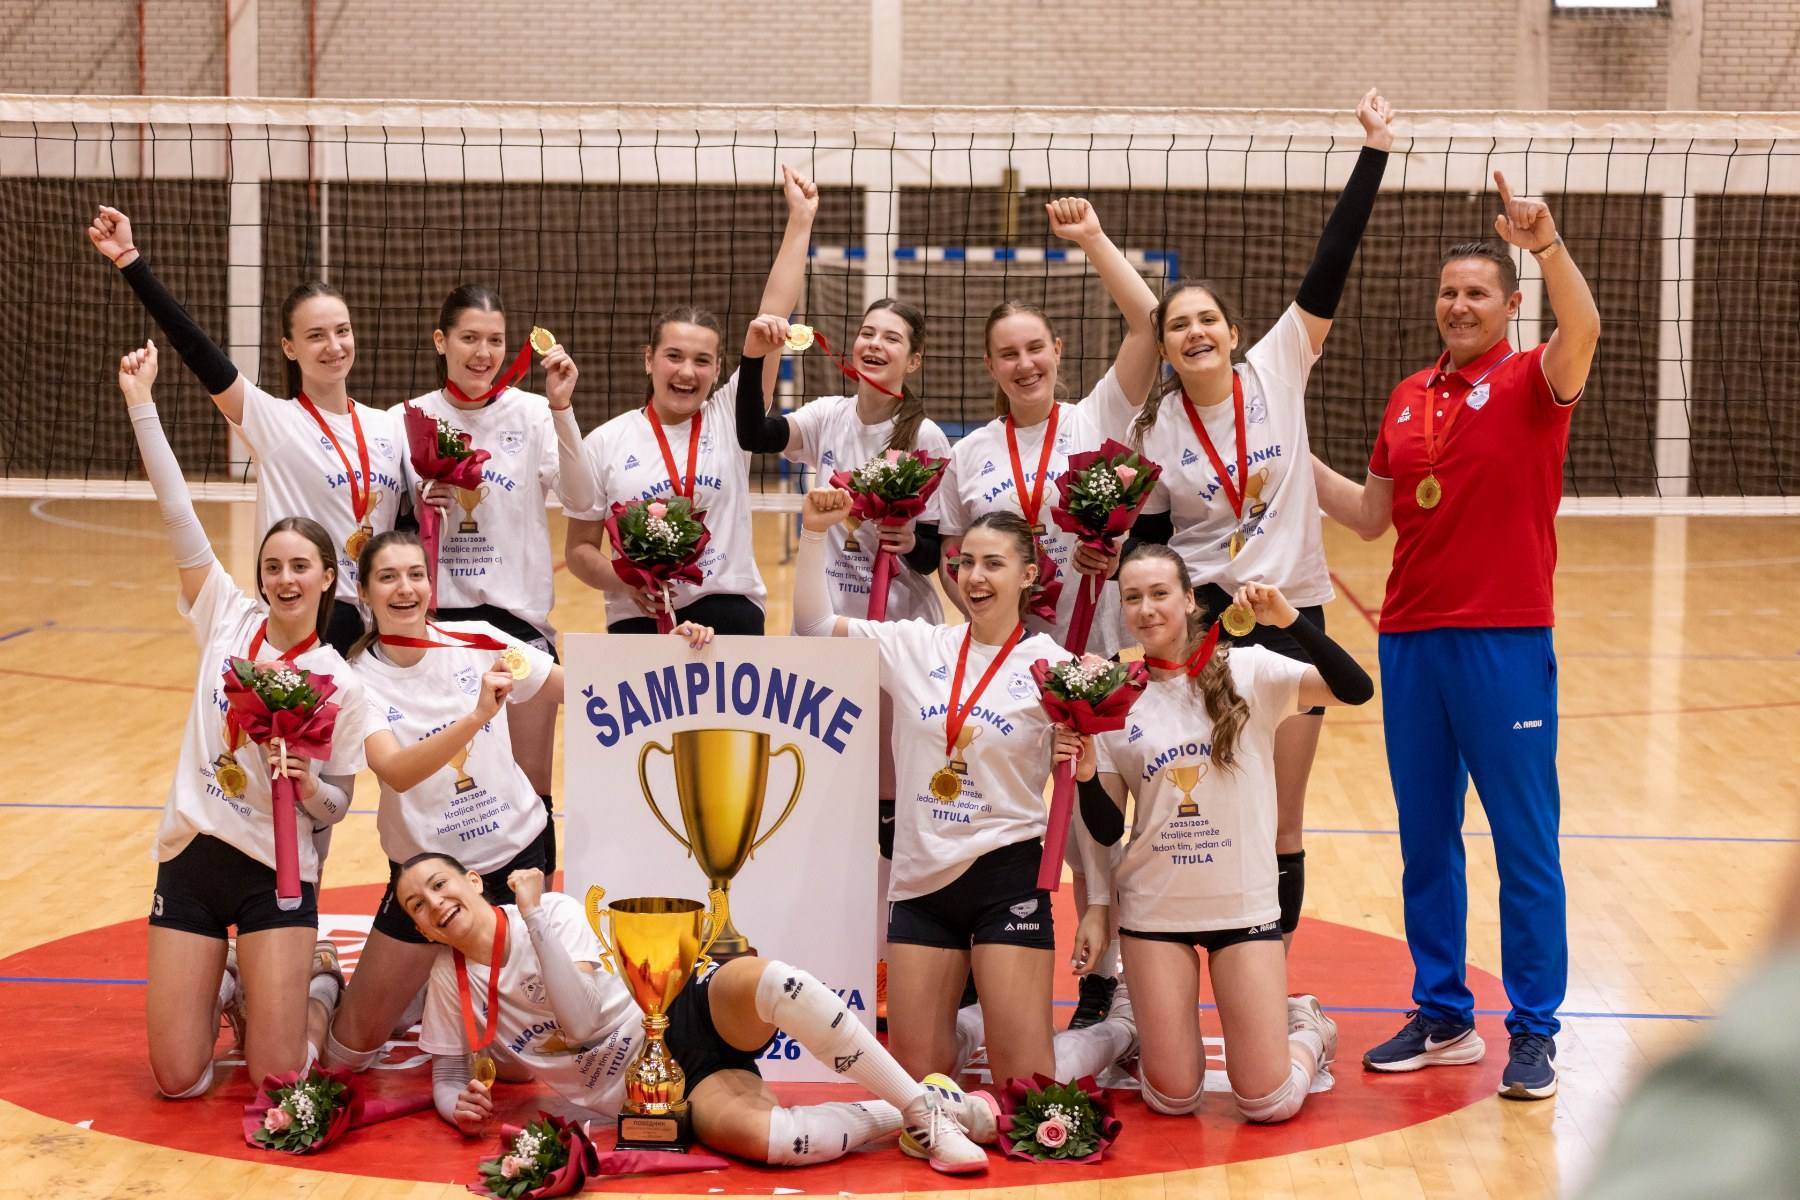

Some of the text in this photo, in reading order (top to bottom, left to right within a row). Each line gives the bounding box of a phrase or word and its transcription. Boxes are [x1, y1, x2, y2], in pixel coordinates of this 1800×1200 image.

[1198, 445, 1282, 502] ŠAPONKE
[632, 475, 722, 501] AMPONKE
[442, 545, 470, 553] Kraljice
[450, 568, 486, 576] TITULA
[581, 661, 862, 754] ŠAMPIONKE
[920, 703, 1014, 736] ŠAMPONKE
[206, 784, 228, 801] TITU
[450, 790, 487, 806] 2025/2026
[917, 793, 938, 804] Jedan
[957, 800, 979, 810] jedan
[444, 805, 474, 820] Kraljice
[933, 809, 970, 823] TITULA
[437, 822, 460, 835] Jedan
[480, 808, 499, 821] jedan
[1169, 820, 1209, 828] 2025/2026
[459, 821, 500, 842] TITULA
[1161, 828, 1220, 840] Kraljice mreže
[1195, 840, 1219, 850] jedan
[1172, 854, 1214, 864] TITULA
[1016, 922, 1040, 931] ARDU
[606, 1037, 633, 1076] TITULA
